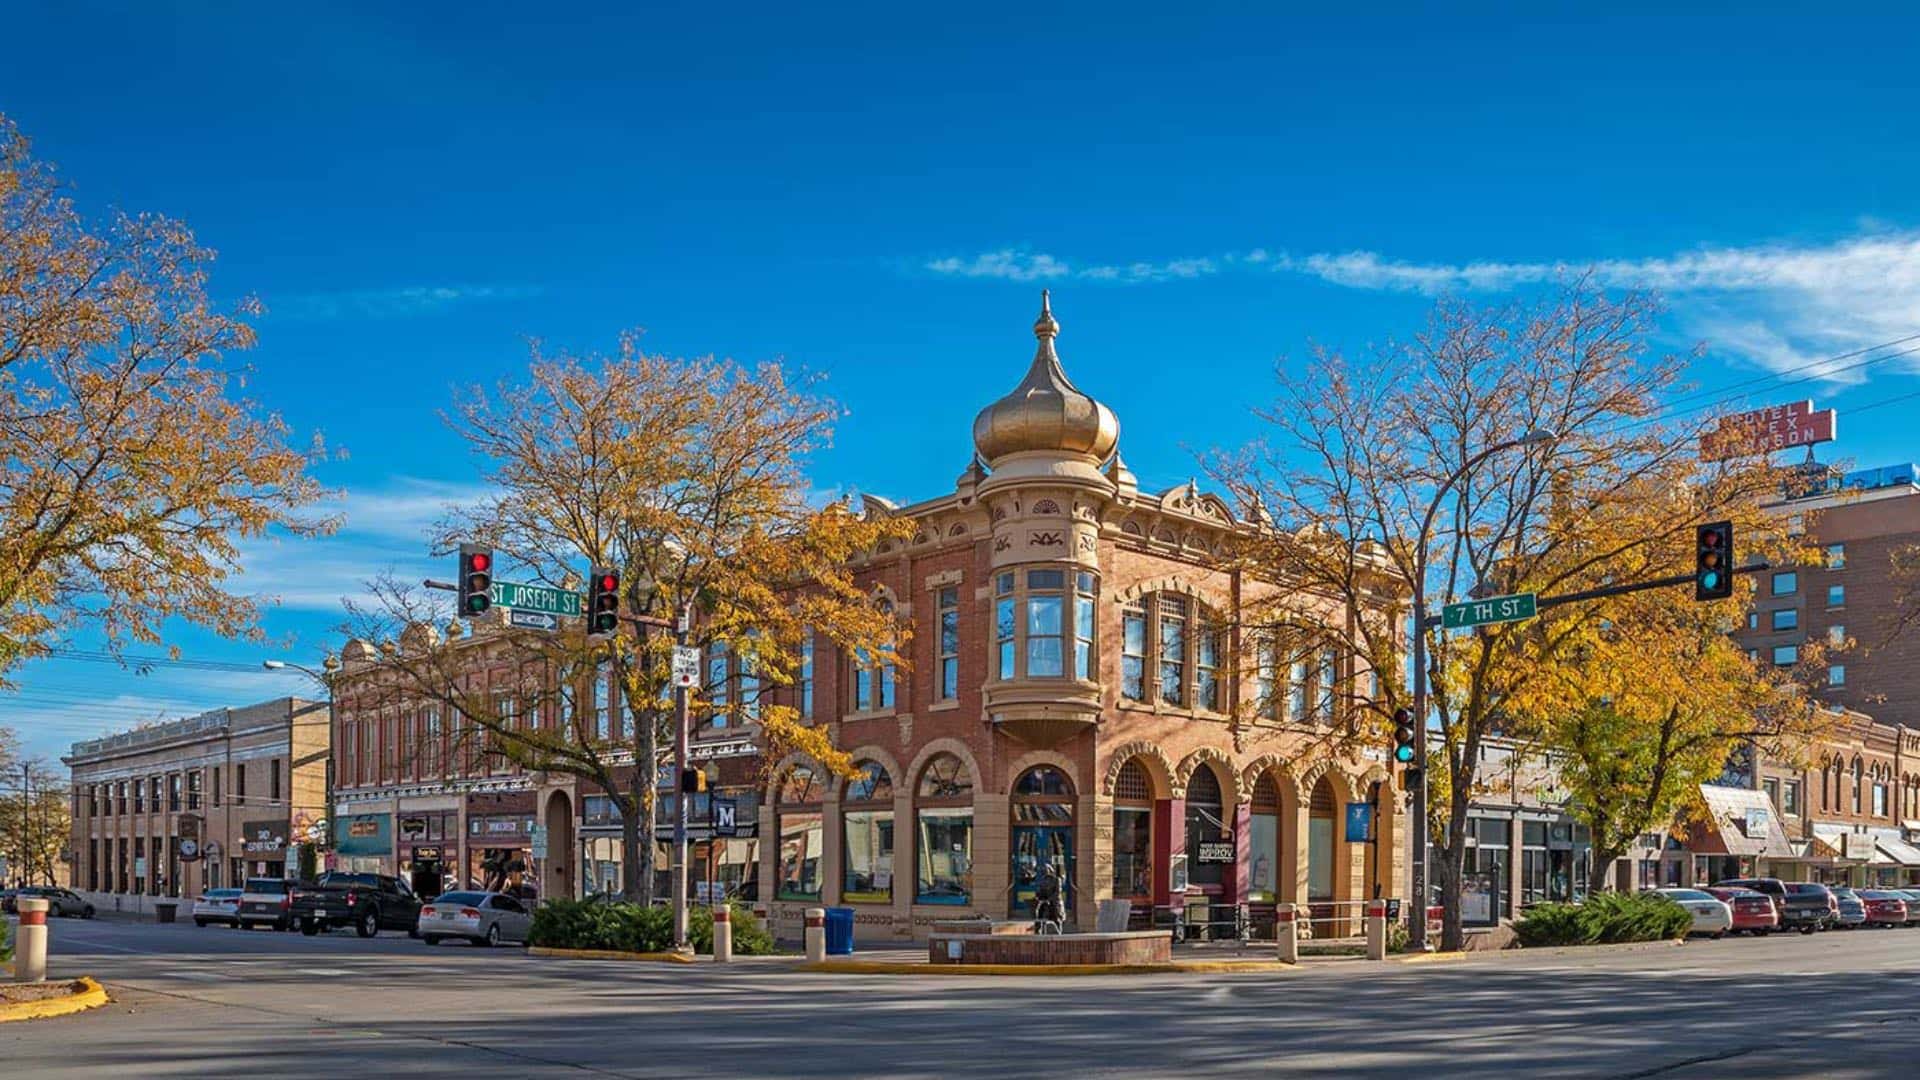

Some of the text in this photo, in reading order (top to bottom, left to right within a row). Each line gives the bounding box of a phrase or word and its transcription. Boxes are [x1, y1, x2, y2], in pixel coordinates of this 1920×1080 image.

[1730, 405, 1798, 424] HOTEL
[491, 583, 577, 613] ST JOSEPH ST
[1456, 599, 1520, 622] 7 TH ST
[680, 649, 693, 658] NO
[719, 807, 735, 826] M
[1199, 847, 1233, 857] IMPROV
